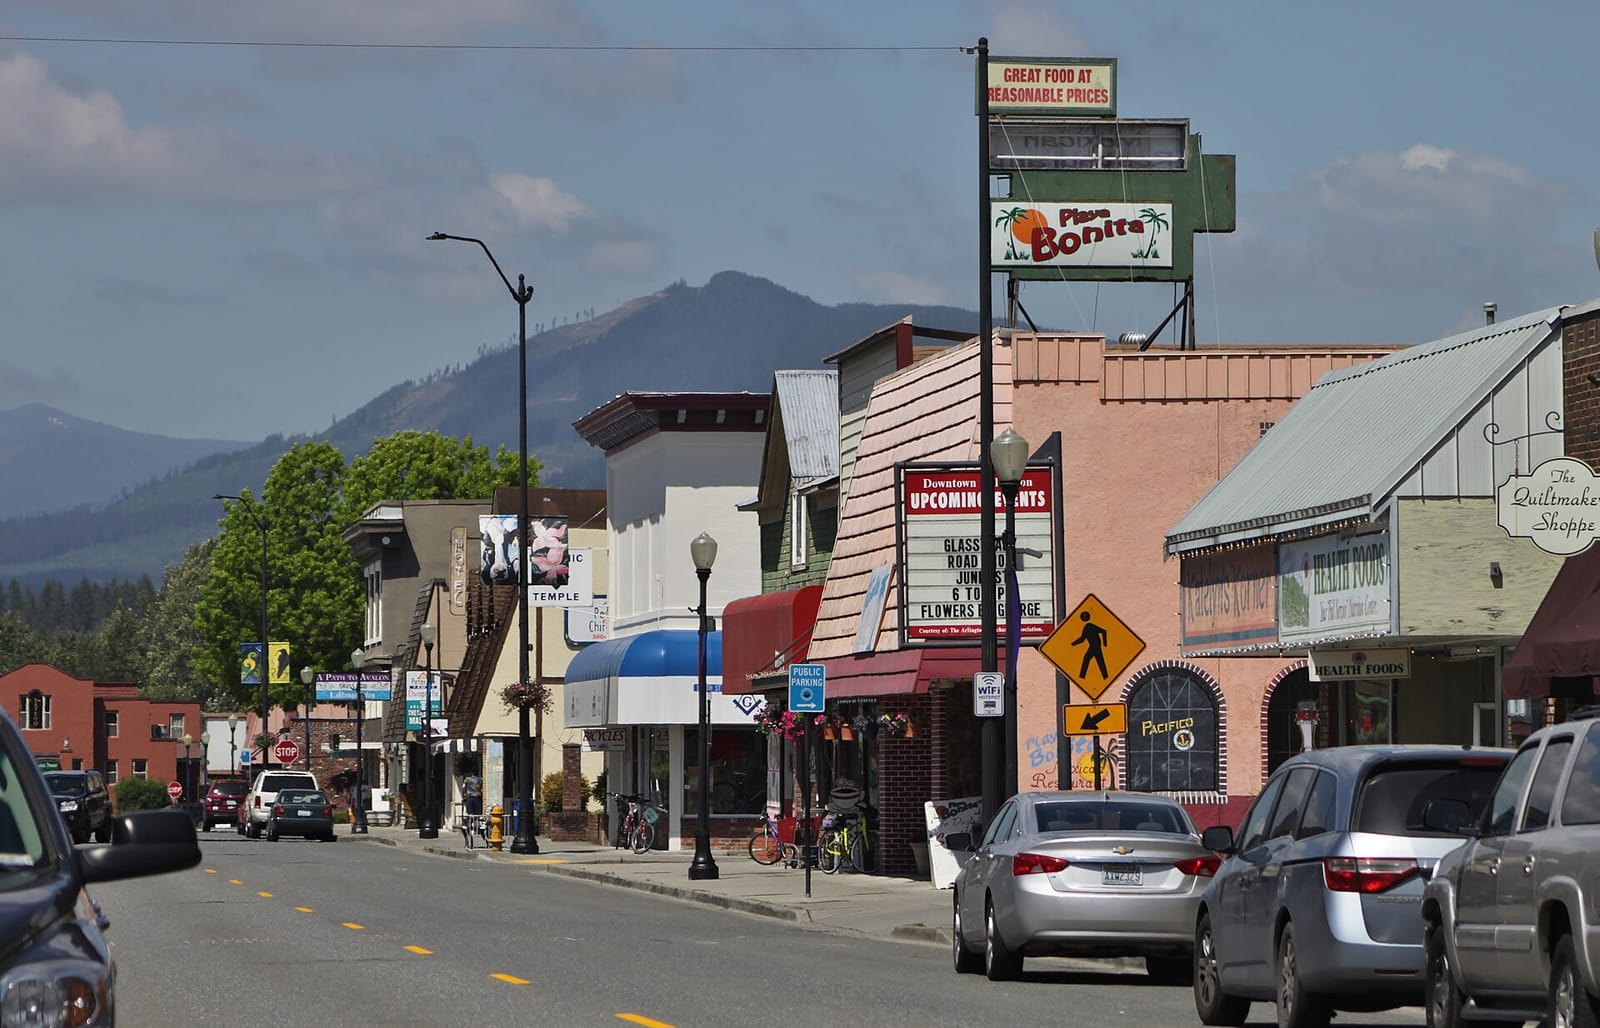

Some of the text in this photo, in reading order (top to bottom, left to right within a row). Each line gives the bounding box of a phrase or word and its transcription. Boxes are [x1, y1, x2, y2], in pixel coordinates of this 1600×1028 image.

[1003, 67, 1093, 83] GREAT FOOD AT
[988, 87, 1109, 104] REASONABLE PRICES
[1059, 208, 1111, 228] Playa
[1030, 217, 1145, 262] Bonita
[1550, 469, 1576, 483] The
[923, 478, 977, 489] Downtown
[1531, 511, 1596, 539] Shoppe
[944, 538, 980, 553] GLASS
[947, 554, 978, 569] ROAD
[1313, 542, 1385, 595] HEALTH FOODS
[532, 592, 580, 601] TEMPLE
[952, 587, 960, 601] 6
[964, 587, 981, 601] TO
[920, 603, 975, 618] FLOWERS
[997, 602, 1041, 617] GRGE
[793, 667, 821, 676] PUBLIC
[1315, 663, 1404, 676] HEALTH FOODS
[791, 678, 823, 687] PARKING
[978, 686, 1001, 694] WiFi
[582, 729, 625, 742] BICYCLES
[275, 747, 297, 757] STOP
